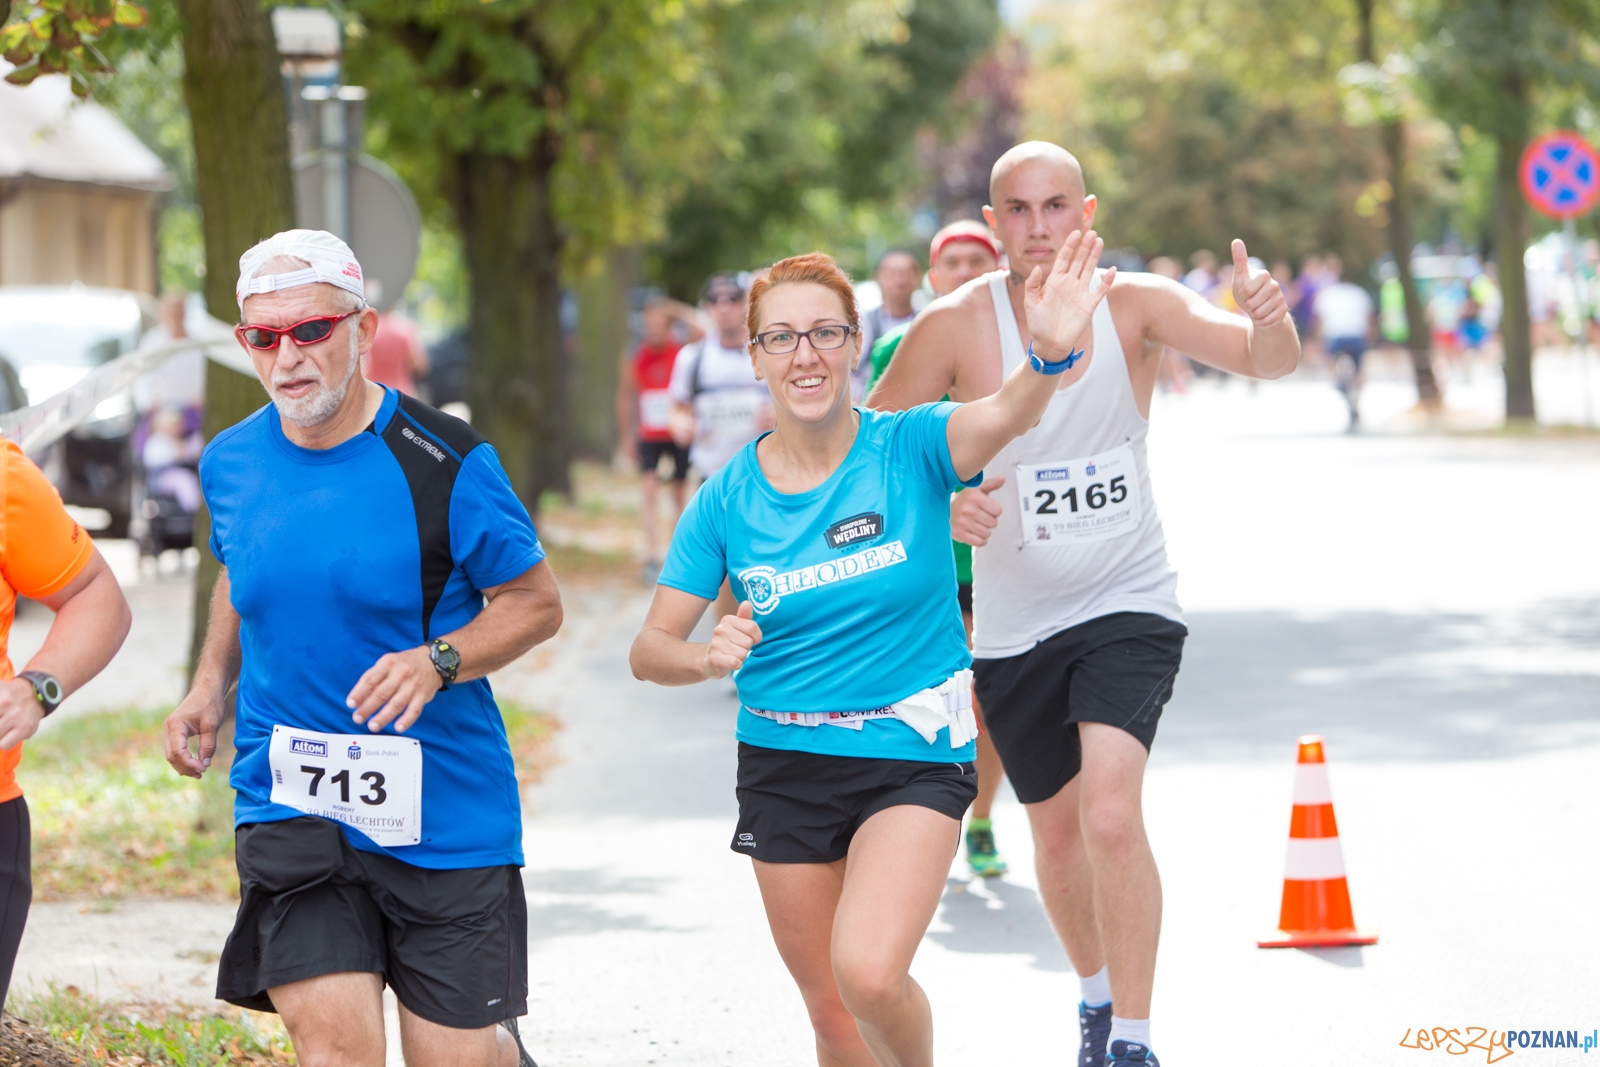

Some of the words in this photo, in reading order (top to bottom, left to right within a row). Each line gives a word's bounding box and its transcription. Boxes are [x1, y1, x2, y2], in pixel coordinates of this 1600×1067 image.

[412, 436, 446, 463] EXTREME
[1034, 474, 1128, 515] 2165
[833, 523, 877, 545] WĘDLINY
[365, 749, 380, 757] Bank
[300, 765, 387, 806] 713
[333, 805, 355, 813] ROBERT
[350, 815, 406, 827] LECHITÓW
